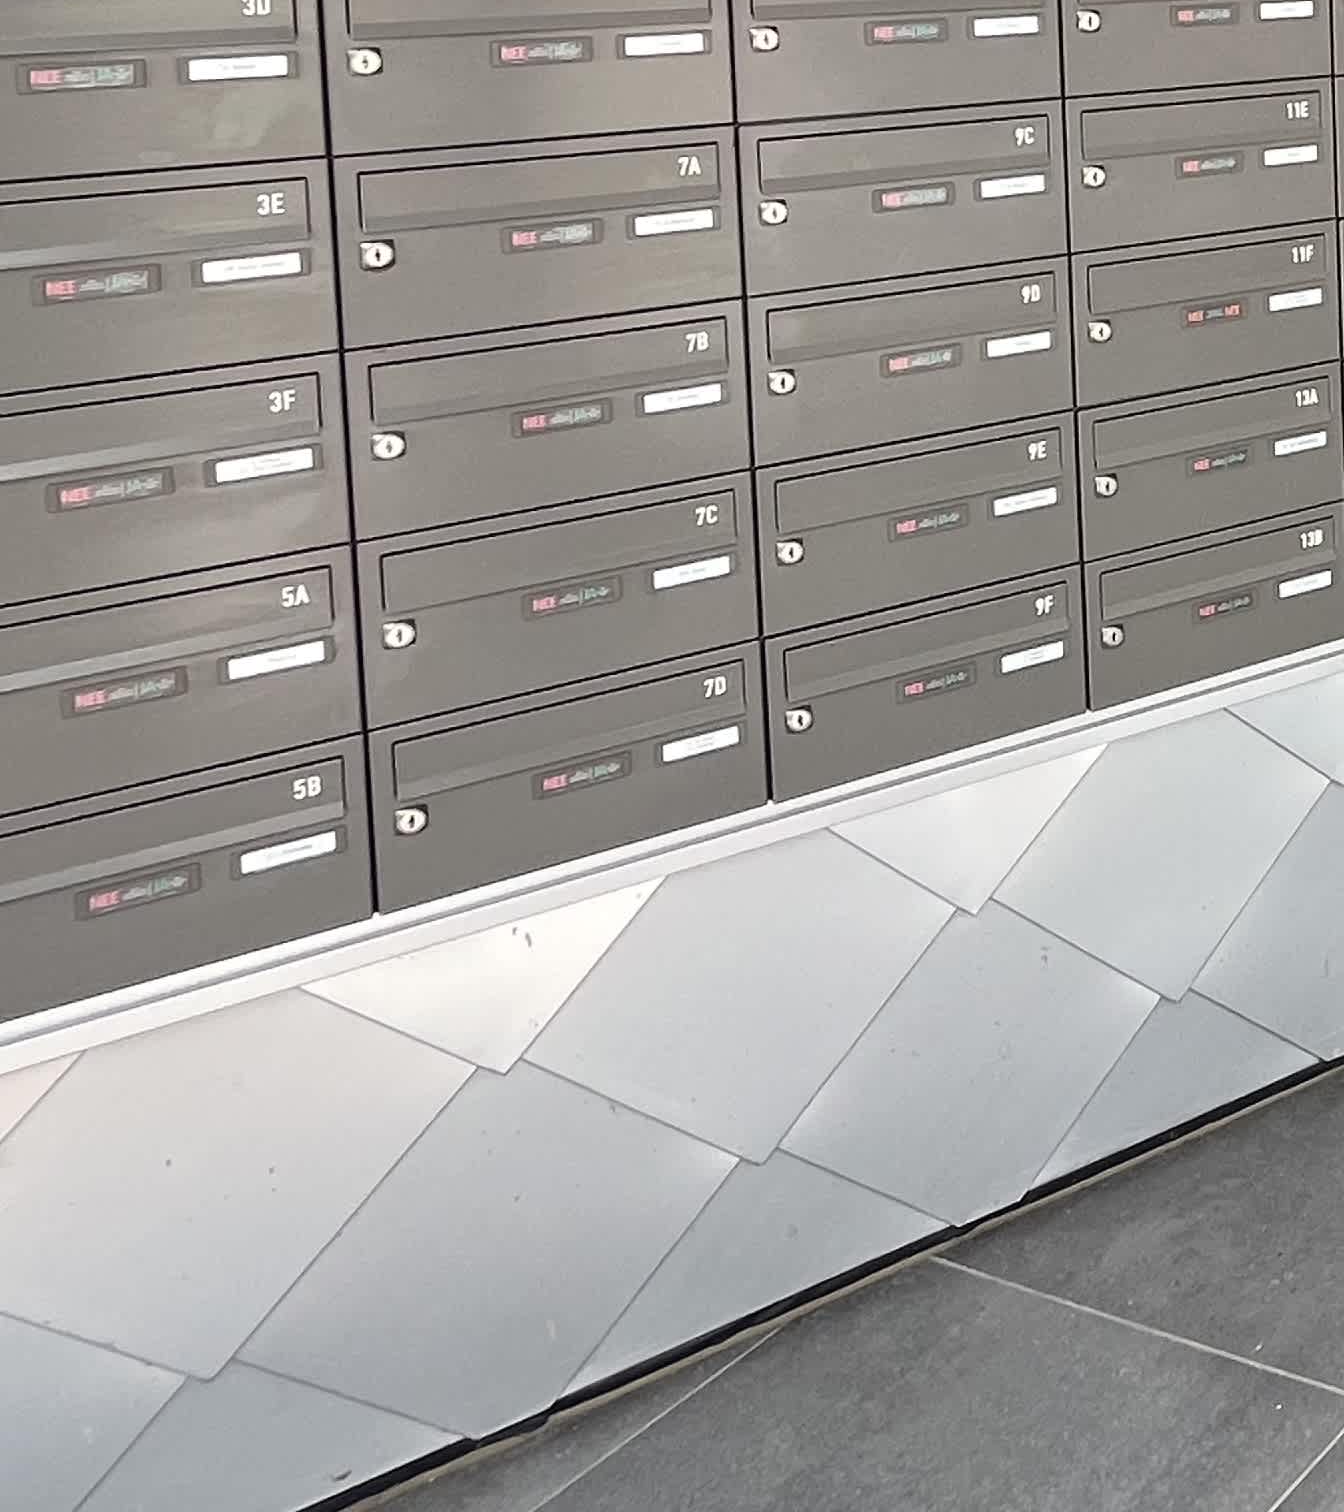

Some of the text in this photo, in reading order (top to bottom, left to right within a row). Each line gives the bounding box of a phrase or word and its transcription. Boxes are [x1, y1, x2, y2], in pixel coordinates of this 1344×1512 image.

[1286, 100, 1309, 119] 11E
[1015, 126, 1035, 146] 9C
[677, 156, 701, 176] 7A
[257, 192, 286, 216] 3E
[1291, 245, 1315, 265] 11F
[1021, 284, 1041, 304] 9D
[685, 331, 709, 353] 7B
[268, 389, 296, 413] 3F
[1295, 388, 1319, 407] 13A
[1028, 440, 1047, 461] 9E
[694, 505, 719, 528] 7C
[281, 584, 310, 608] 5A
[1035, 596, 1054, 617] 9F
[702, 676, 727, 699] 7D
[293, 776, 322, 801] 5B
